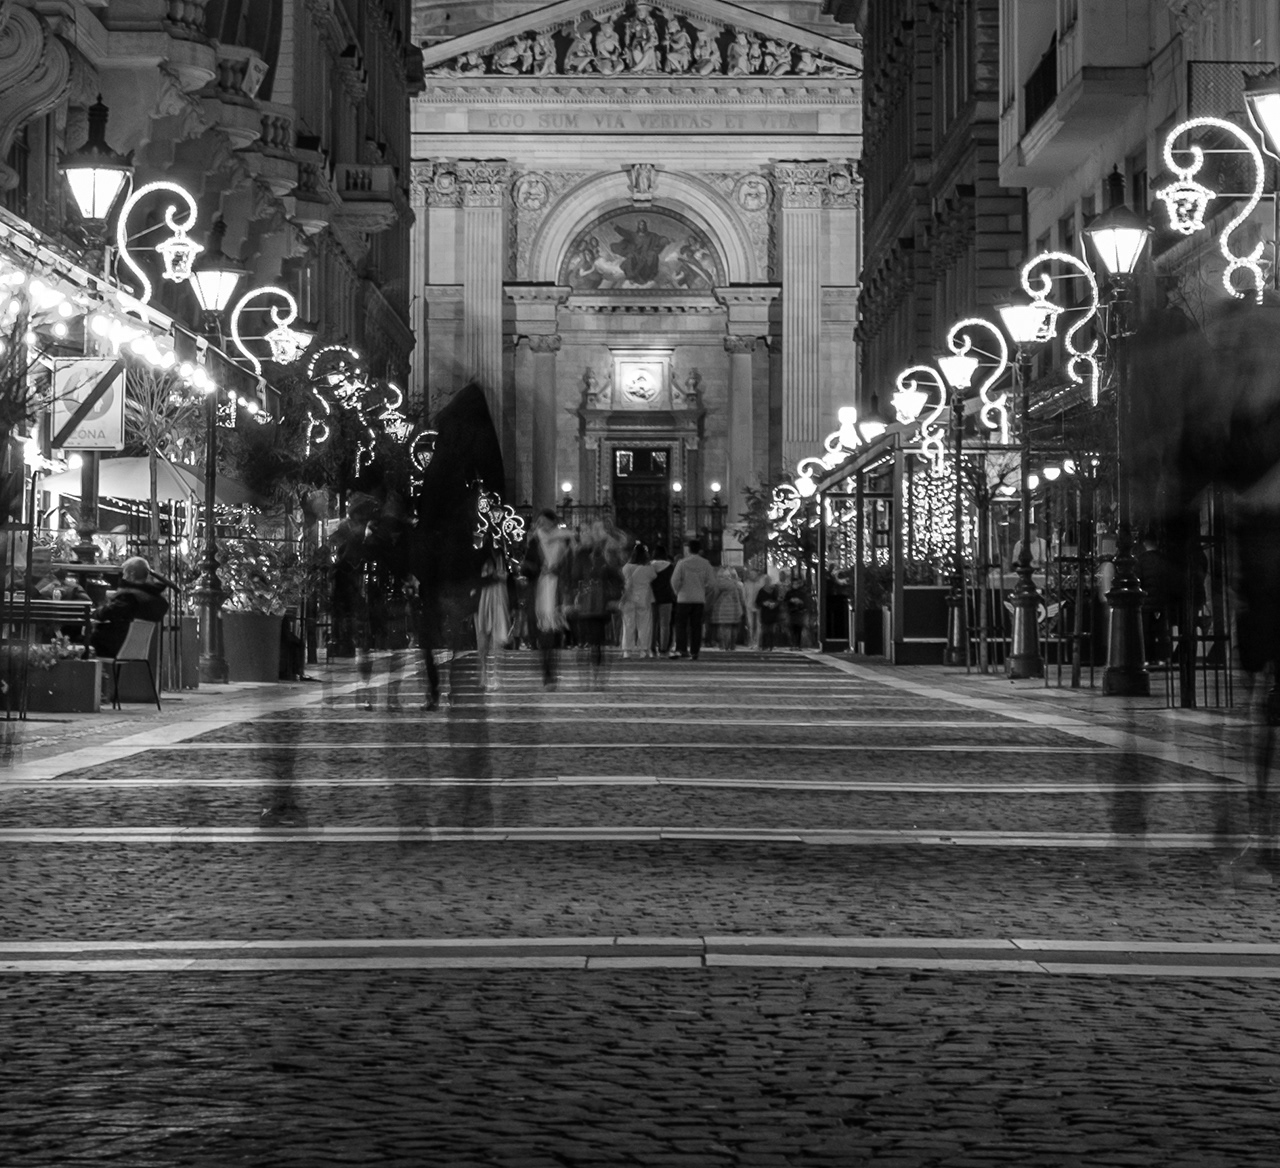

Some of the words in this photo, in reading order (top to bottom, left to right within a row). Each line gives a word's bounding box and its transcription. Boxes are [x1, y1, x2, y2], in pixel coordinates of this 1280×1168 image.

[487, 113, 525, 128] EGO
[538, 113, 579, 128] SUM
[593, 113, 626, 129] VIA
[637, 113, 713, 129] VERITAS
[724, 113, 747, 129] ET
[758, 113, 799, 129] VITA
